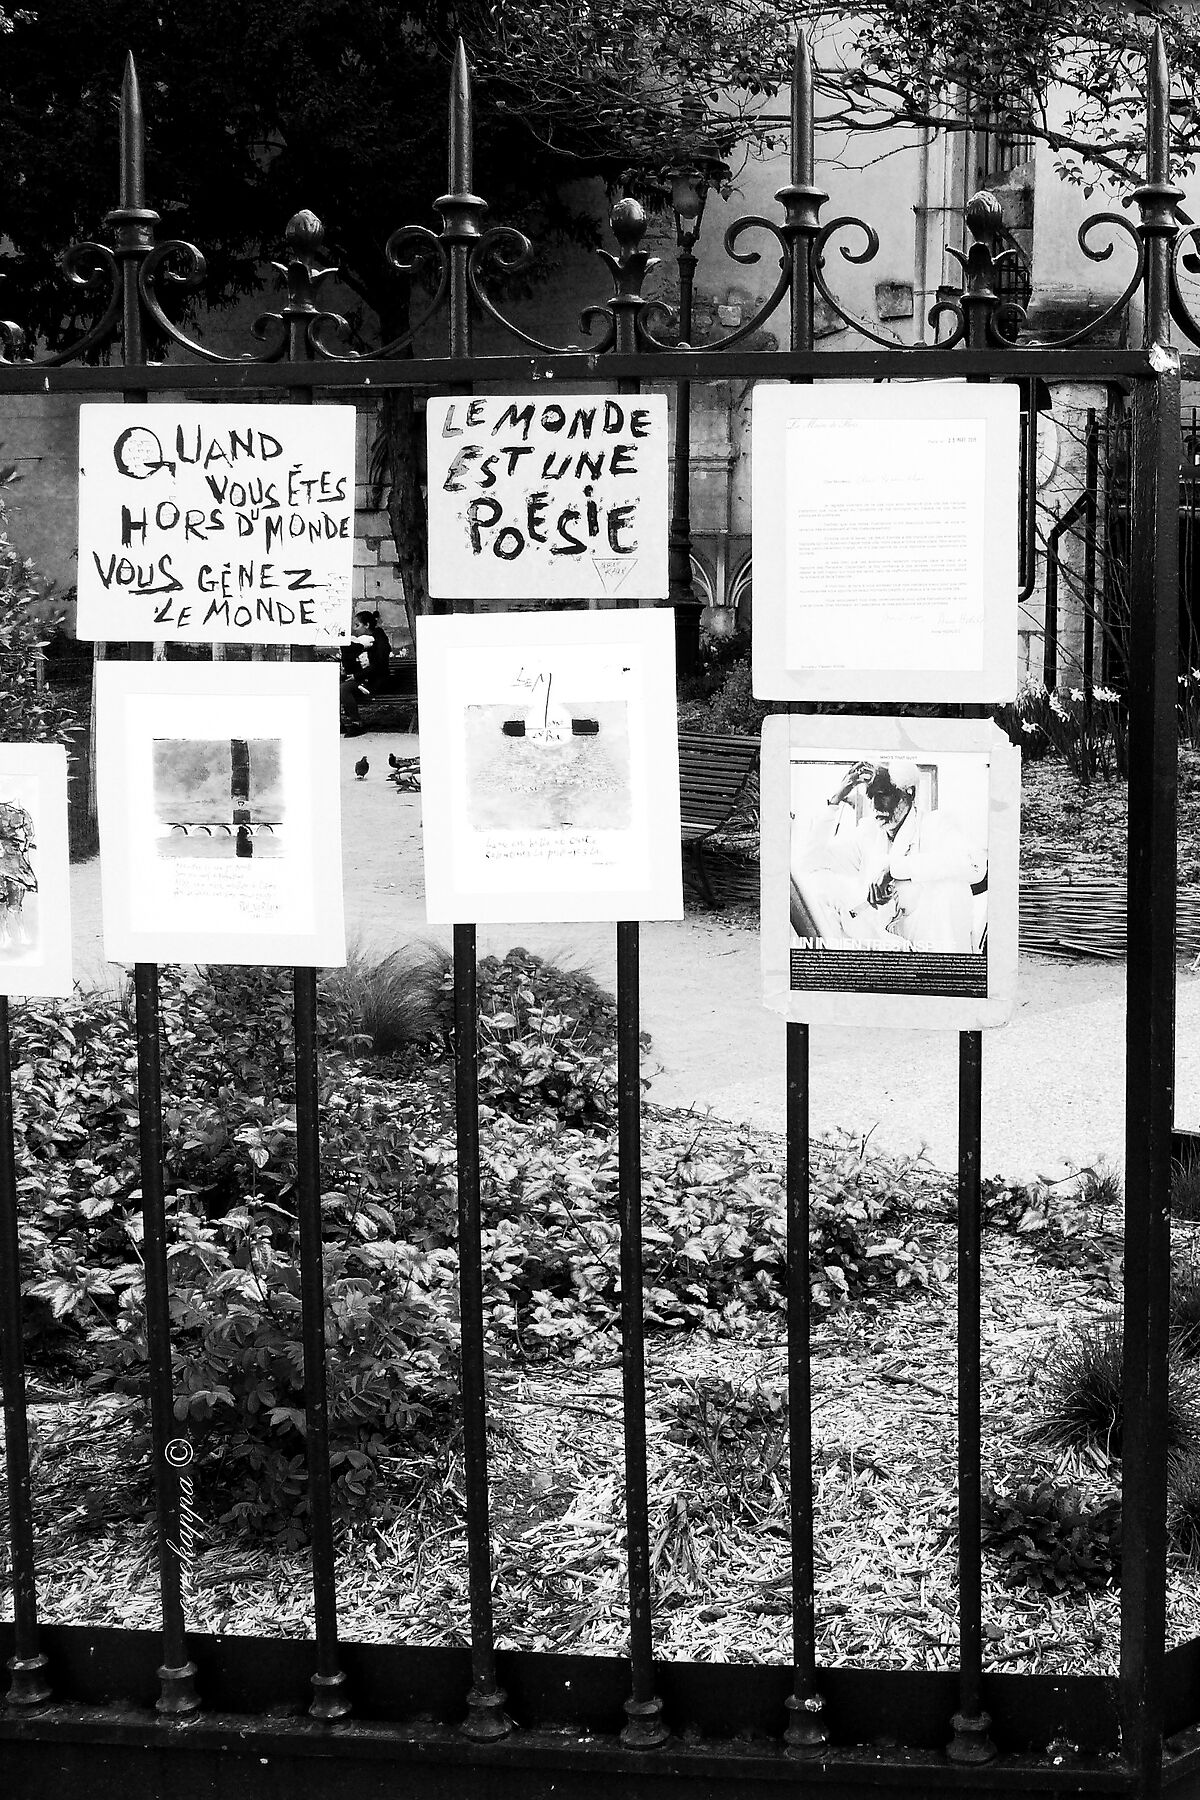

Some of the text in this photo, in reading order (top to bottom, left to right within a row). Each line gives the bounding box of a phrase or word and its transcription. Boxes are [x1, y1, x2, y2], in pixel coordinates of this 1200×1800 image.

[442, 399, 651, 440] LE MONDE
[113, 424, 283, 479] QUAND
[443, 444, 638, 491] EST UNE
[205, 475, 280, 509] VOUS
[121, 501, 224, 548] HORS
[265, 511, 350, 554] MONDE
[93, 551, 184, 595] VOUS
[153, 597, 317, 627] LE MONDE
